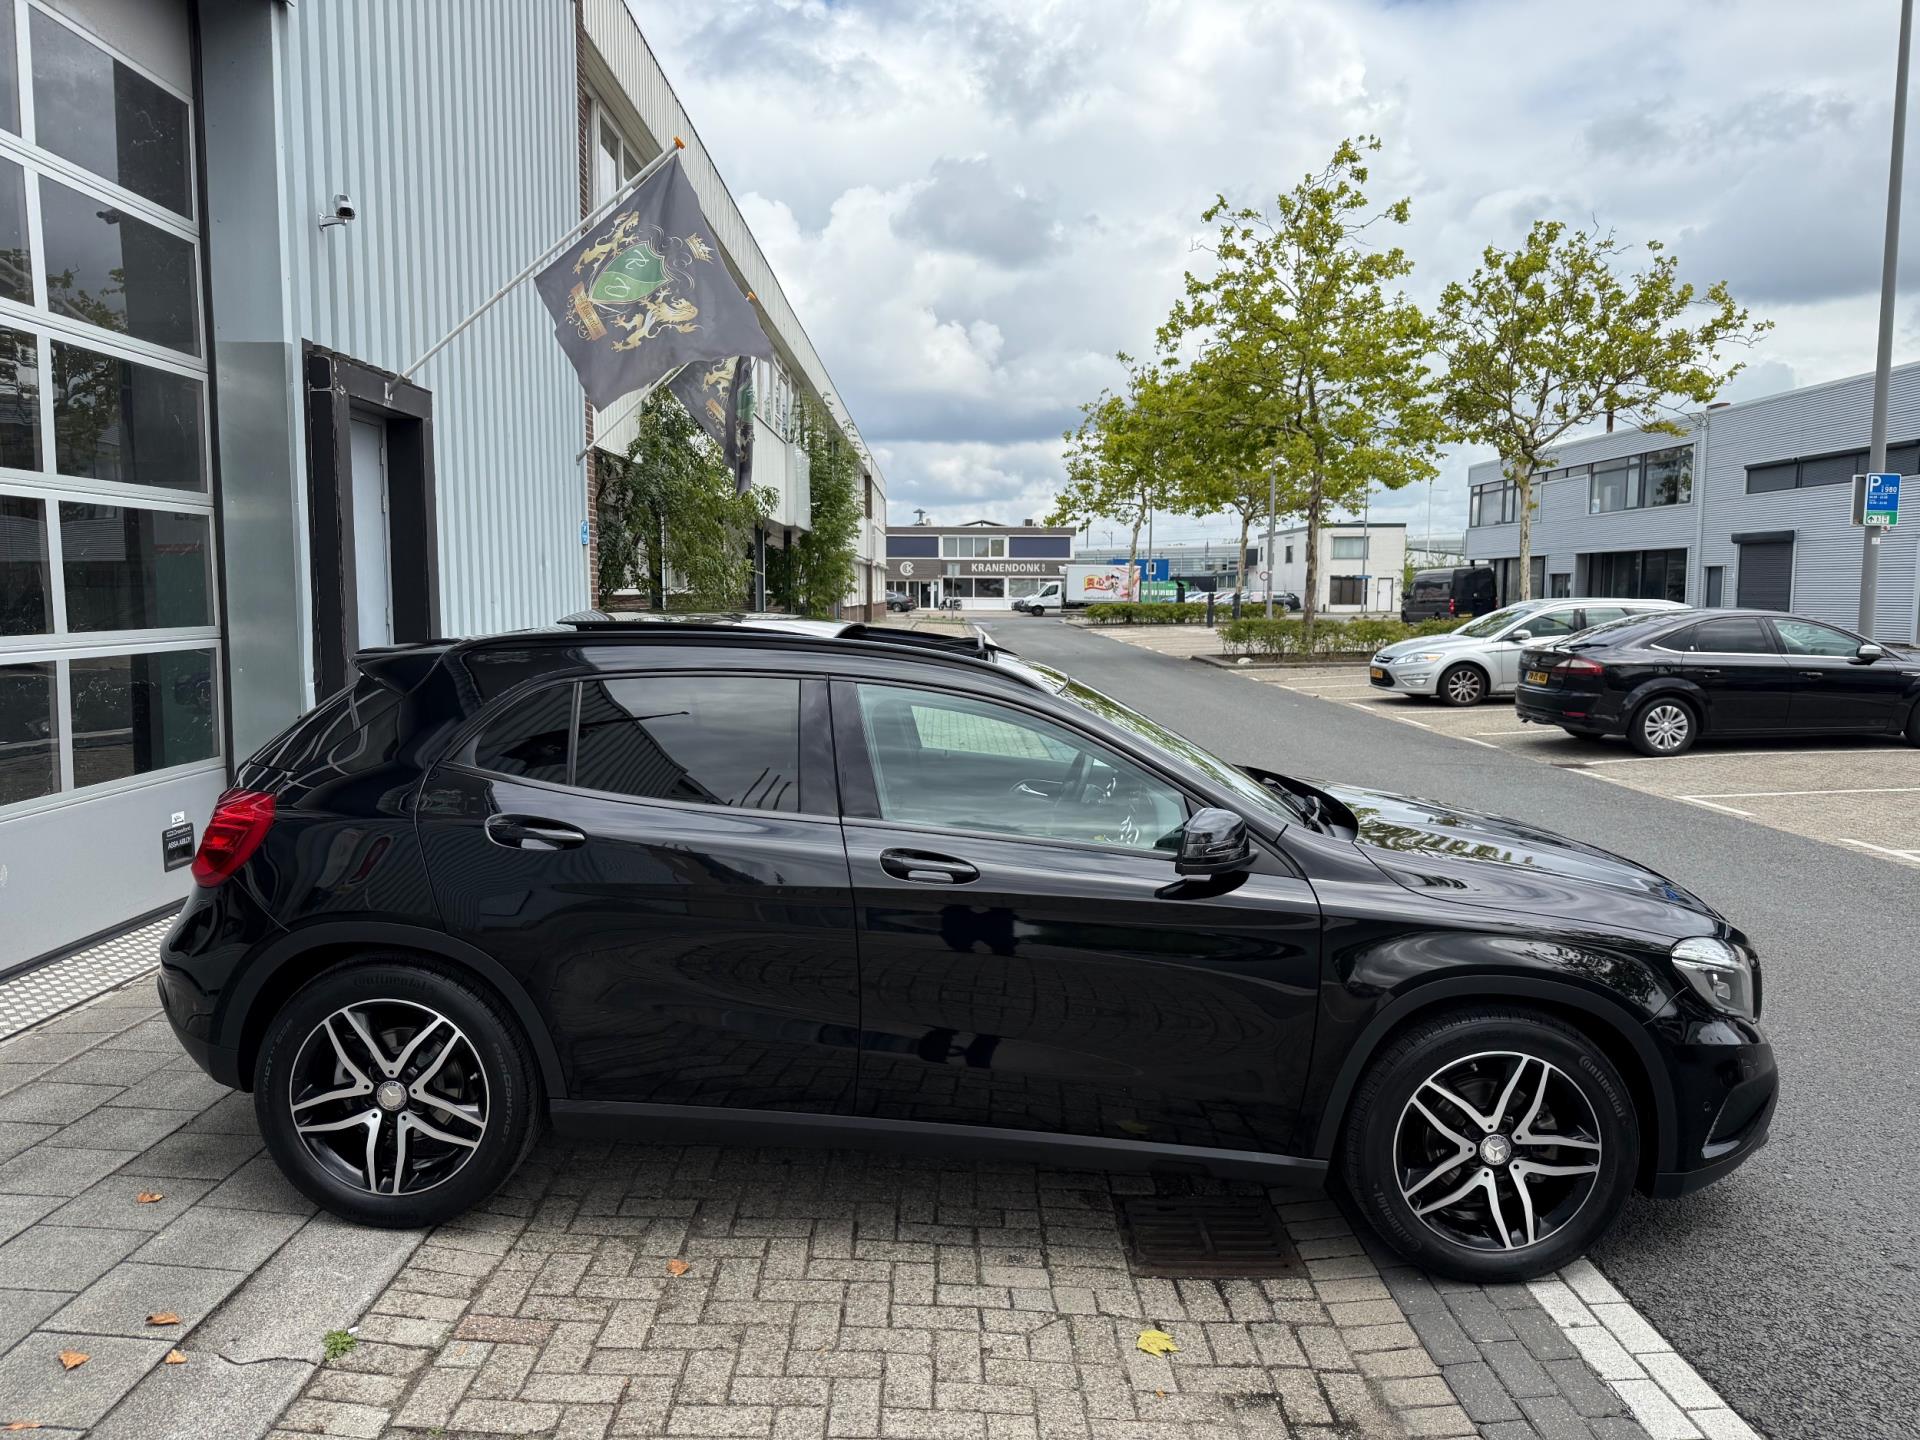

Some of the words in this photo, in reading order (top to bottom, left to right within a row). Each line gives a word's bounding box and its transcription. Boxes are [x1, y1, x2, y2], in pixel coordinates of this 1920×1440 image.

[1870, 476, 1882, 493] P
[971, 563, 1041, 572] KRANENDONK
[1579, 1055, 1625, 1117] Continental
